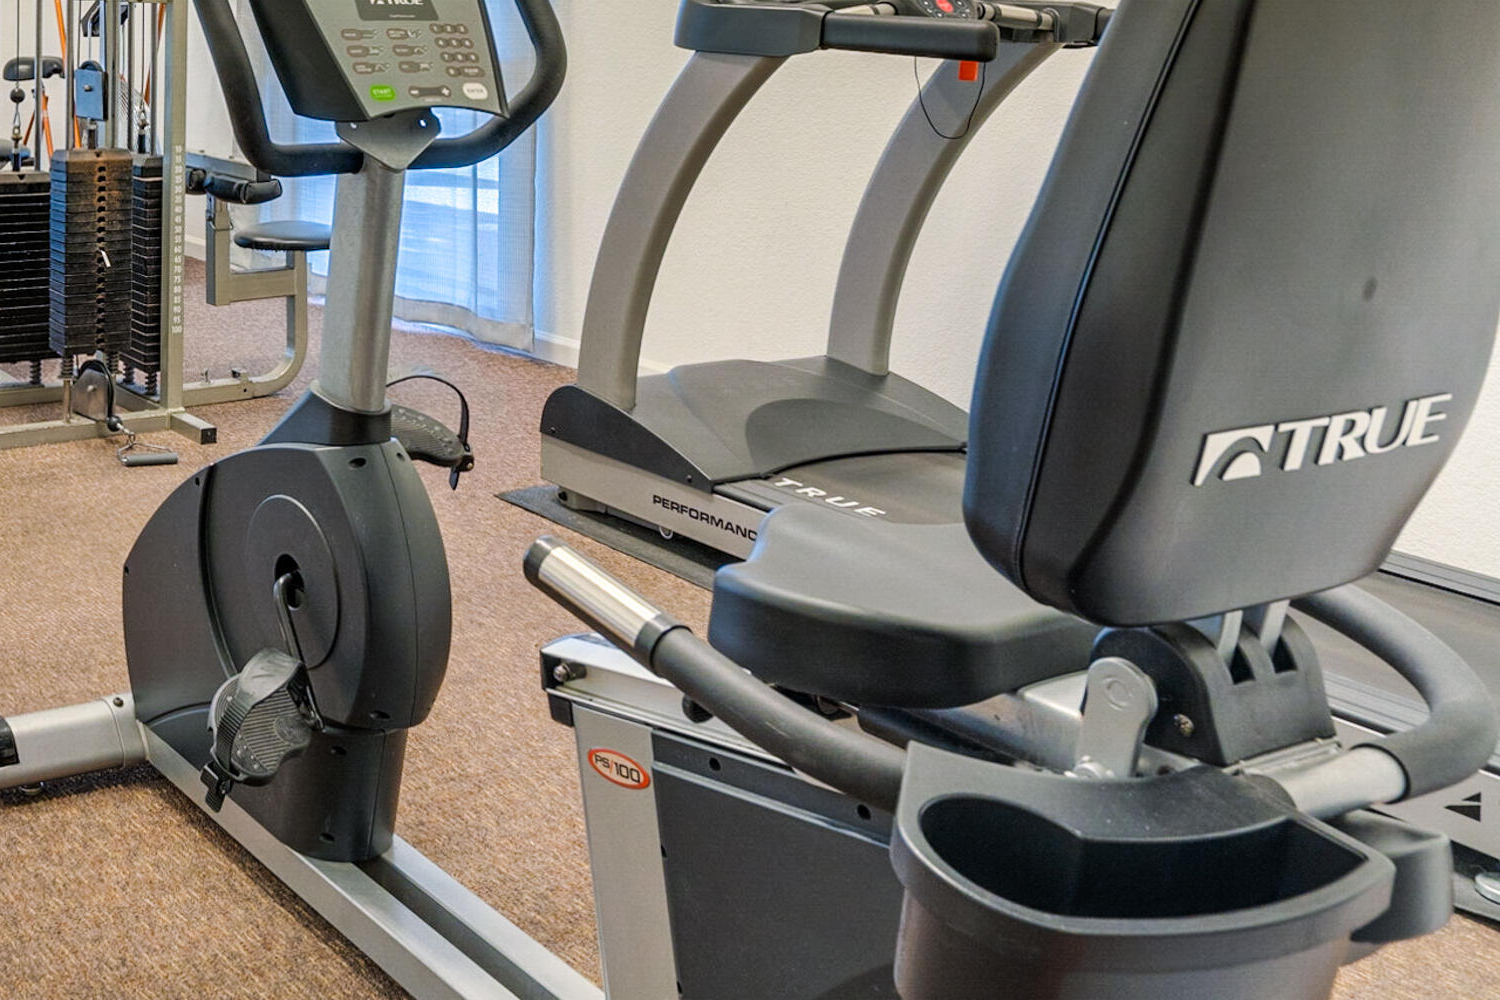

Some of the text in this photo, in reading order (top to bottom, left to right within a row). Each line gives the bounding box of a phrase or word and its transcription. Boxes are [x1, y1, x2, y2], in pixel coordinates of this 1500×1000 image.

[1277, 393, 1452, 471] TRUE
[652, 494, 758, 542] PERFORMANC
[771, 477, 887, 518] TRUE
